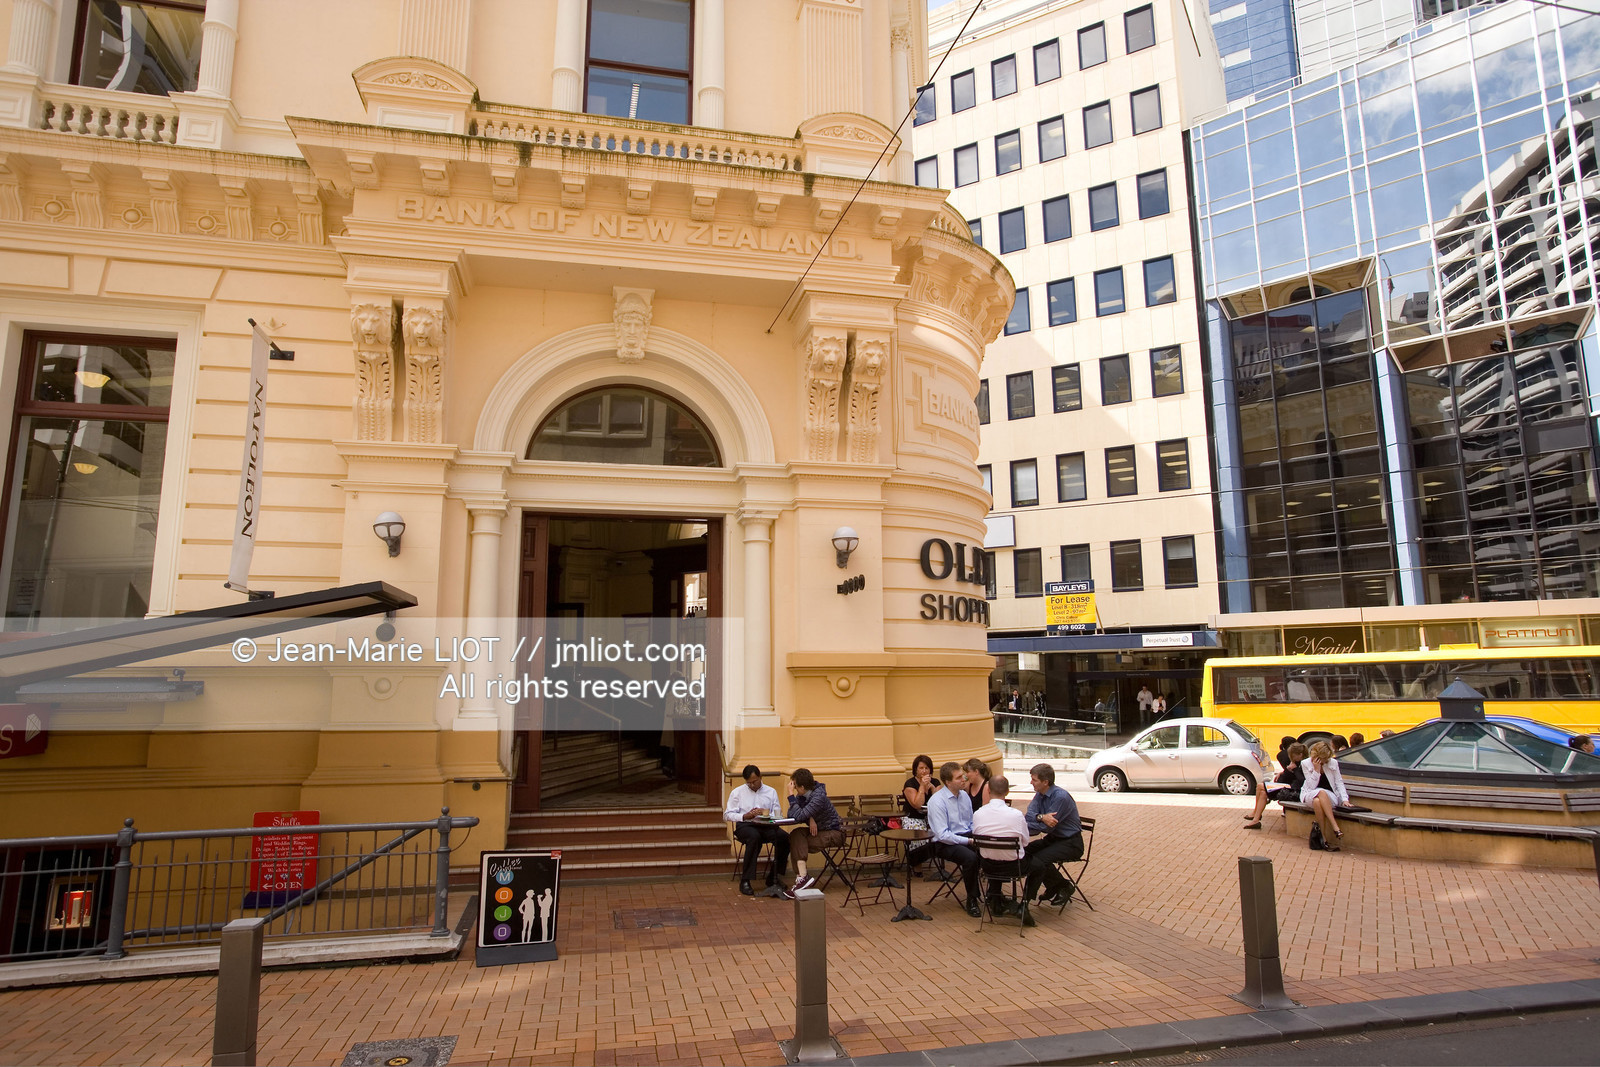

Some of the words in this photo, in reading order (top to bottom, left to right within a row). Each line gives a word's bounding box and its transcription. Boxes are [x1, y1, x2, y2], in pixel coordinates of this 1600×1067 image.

[397, 197, 515, 229] BANK
[528, 206, 582, 233] OF
[592, 213, 676, 242] NEW
[927, 388, 966, 427] BANK
[241, 378, 264, 538] NAPOLEON
[920, 537, 987, 586] OLD
[1052, 584, 1087, 592] BAYLEYS
[1065, 596, 1091, 604] Lease
[1484, 628, 1575, 638] PLATINUM
